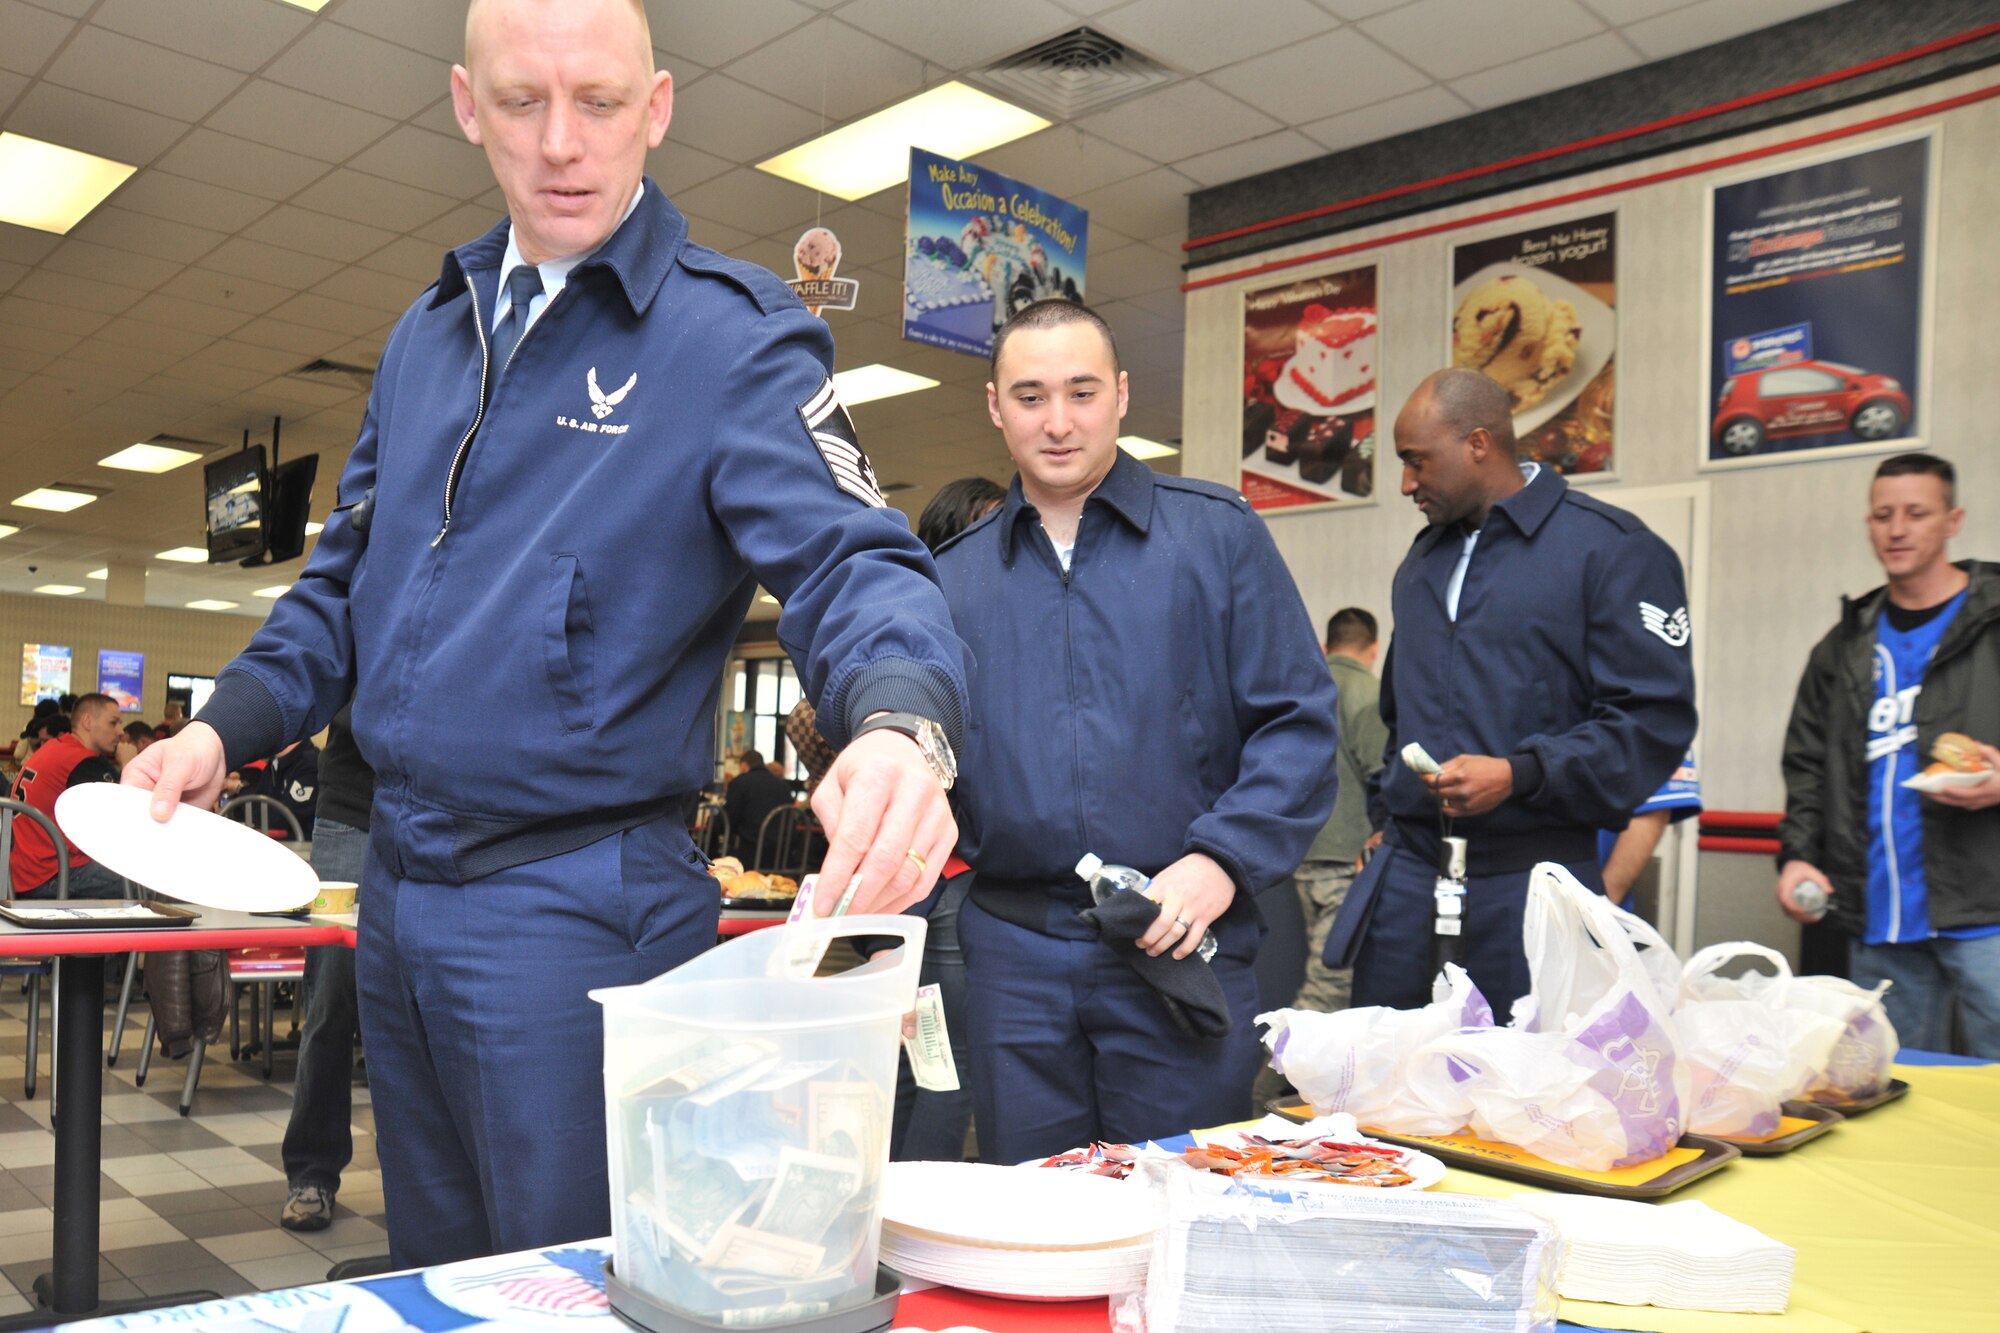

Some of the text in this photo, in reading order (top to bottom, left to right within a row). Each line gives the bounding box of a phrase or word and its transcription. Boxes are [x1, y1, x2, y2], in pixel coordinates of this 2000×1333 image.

[928, 164, 978, 187] Make Any
[942, 183, 995, 213] Occasion
[998, 197, 1007, 214] a
[1010, 194, 1078, 256] Celebration!
[1559, 239, 1608, 263] yogurt
[831, 282, 847, 296] IT!
[556, 415, 568, 426] U.
[569, 418, 579, 429] S.
[580, 421, 598, 432] AIR
[262, 1288, 333, 1310] AIR
